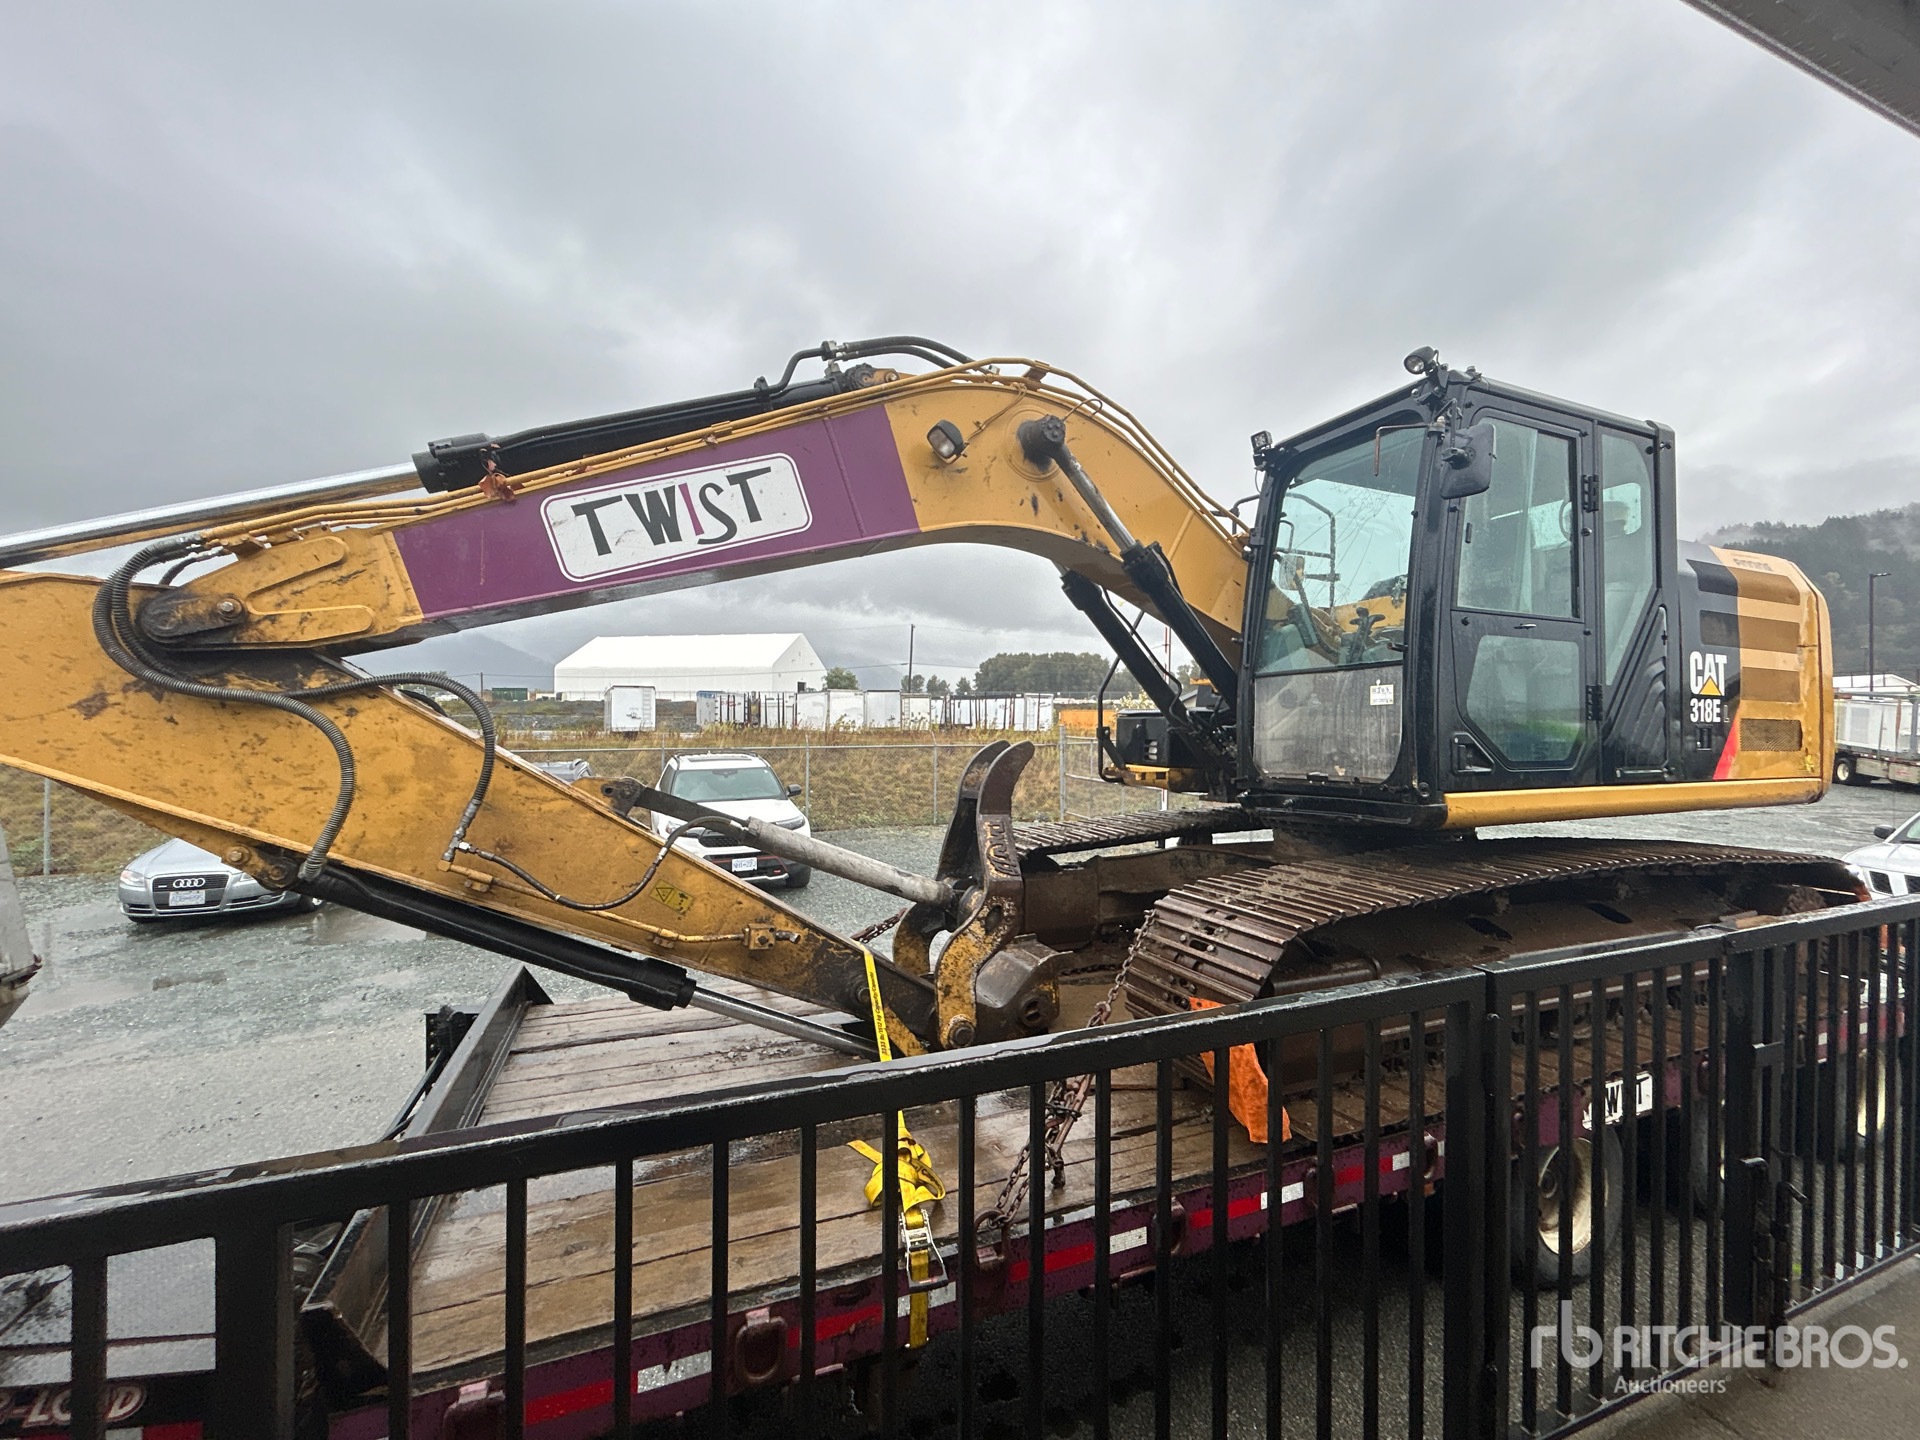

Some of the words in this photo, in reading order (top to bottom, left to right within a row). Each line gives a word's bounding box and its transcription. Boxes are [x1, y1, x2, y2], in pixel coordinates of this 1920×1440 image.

[571, 467, 771, 556] TWIST
[1690, 651, 1727, 696] CAT
[1690, 698, 1721, 723] 318E
